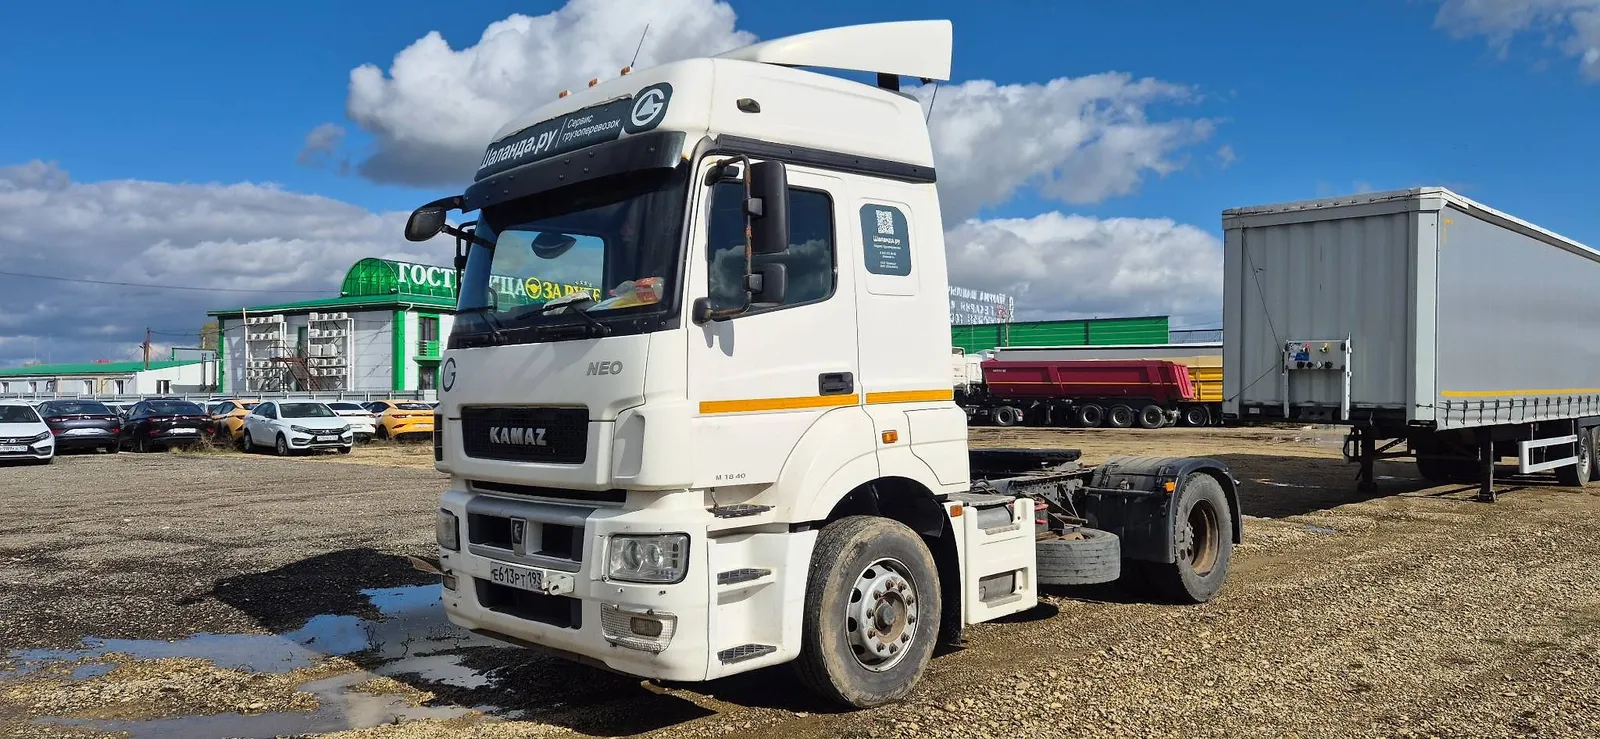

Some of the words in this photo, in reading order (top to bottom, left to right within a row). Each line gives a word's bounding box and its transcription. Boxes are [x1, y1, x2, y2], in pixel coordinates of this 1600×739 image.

[567, 114, 594, 129] Сервис
[561, 118, 621, 143] грузоперевозок
[542, 281, 561, 299] ЗА
[586, 360, 624, 376] NEO
[489, 426, 547, 446] KAMAZ
[527, 571, 542, 586] 193
